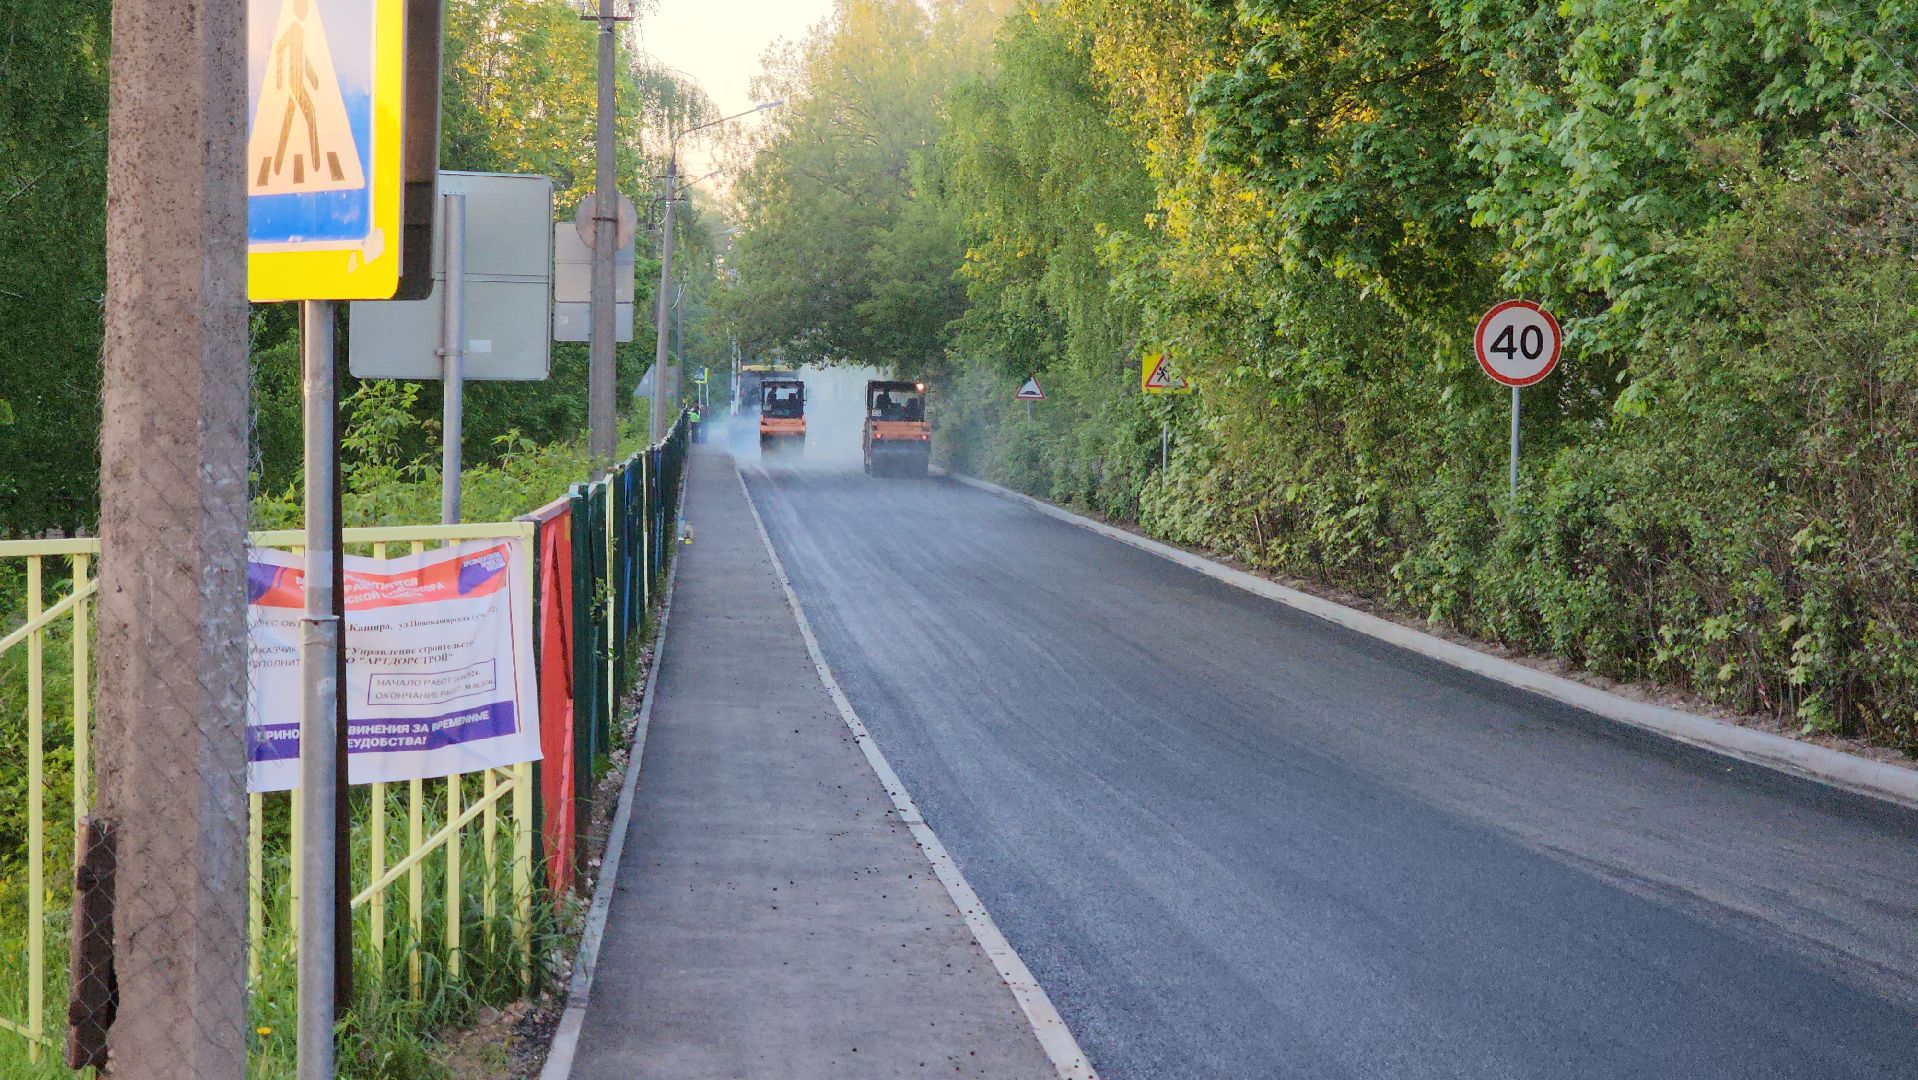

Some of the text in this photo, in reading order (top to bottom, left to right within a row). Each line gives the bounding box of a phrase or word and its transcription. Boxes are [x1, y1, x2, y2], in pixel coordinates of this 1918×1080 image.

[1490, 325, 1543, 360] 40
[376, 678, 422, 688] НАЧАЛО
[347, 723, 410, 736] ВИНЕНИЯ
[412, 723, 430, 734] ЗА
[431, 709, 490, 732] ВРЕМЕННЫЕ
[346, 736, 427, 749] ЕУДОБСТВА!
